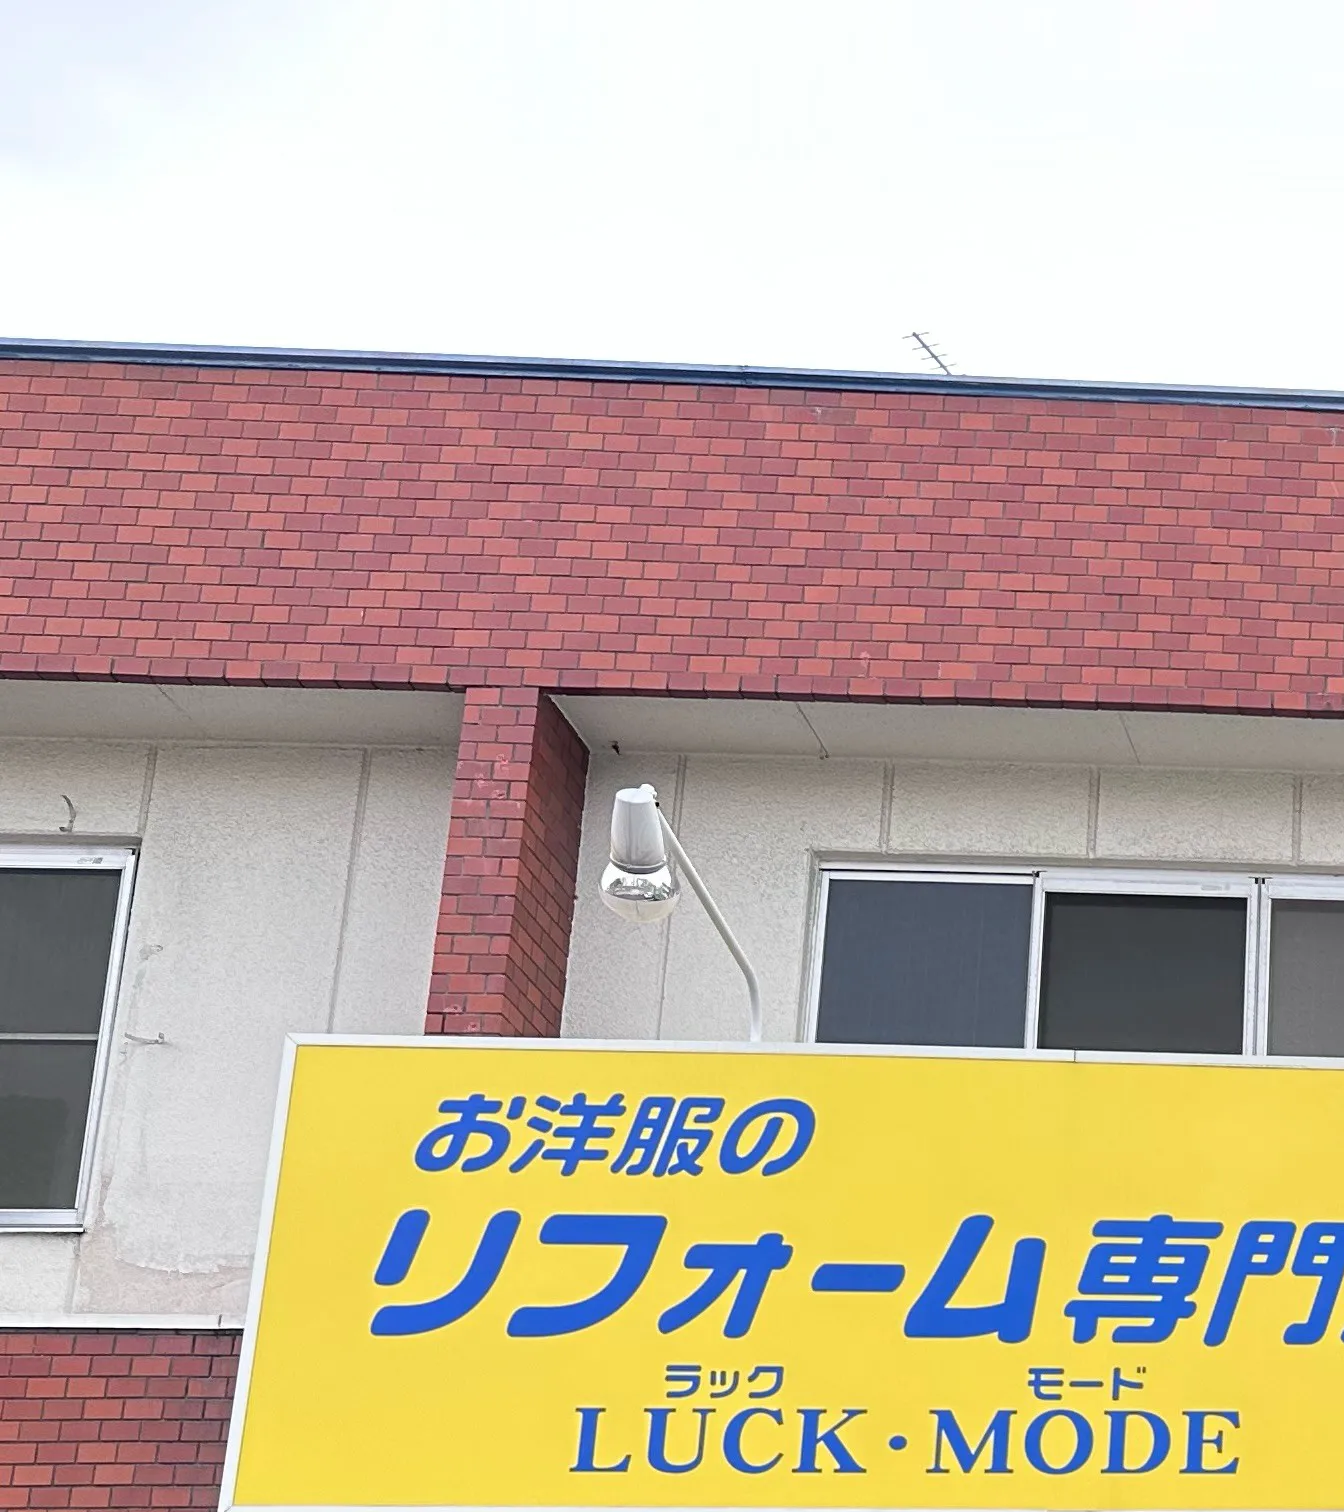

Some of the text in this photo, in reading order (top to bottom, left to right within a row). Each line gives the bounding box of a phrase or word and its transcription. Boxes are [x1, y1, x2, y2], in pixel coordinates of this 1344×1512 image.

[414, 1093, 815, 1177] お洋服の
[664, 1365, 786, 1399] ラック
[1027, 1366, 1147, 1401] モード
